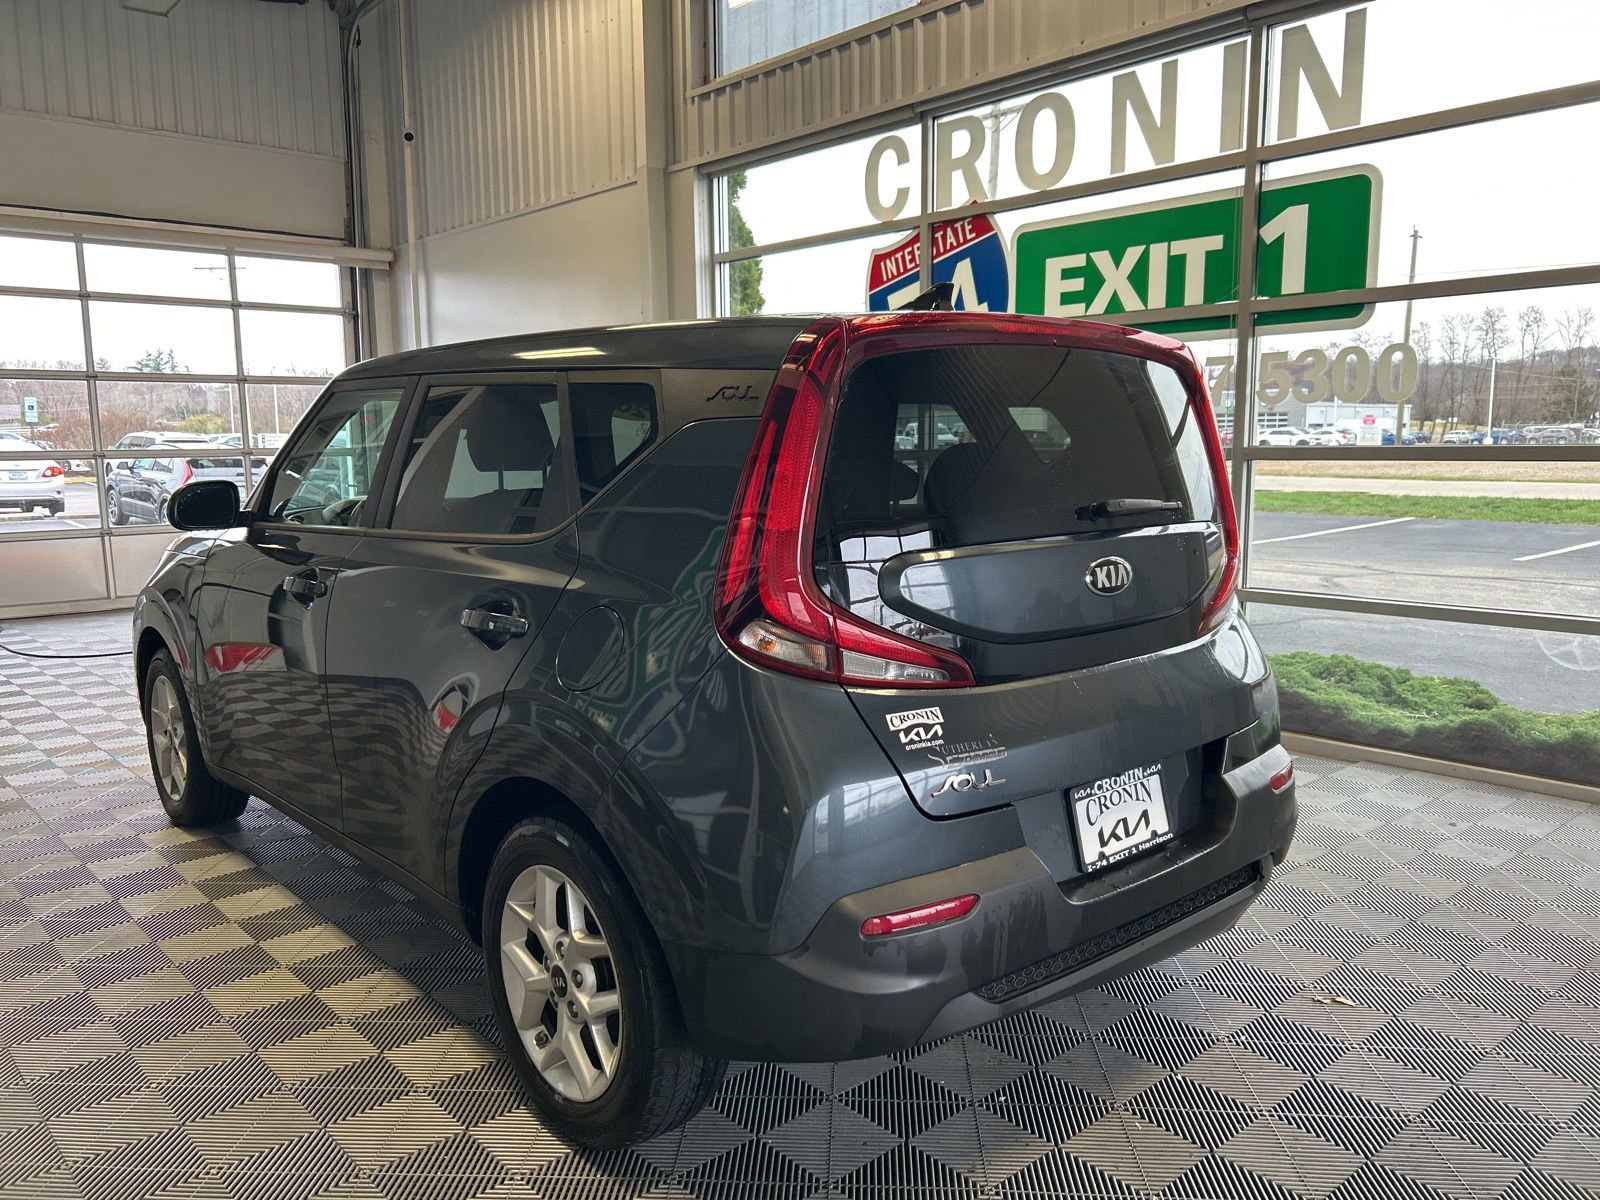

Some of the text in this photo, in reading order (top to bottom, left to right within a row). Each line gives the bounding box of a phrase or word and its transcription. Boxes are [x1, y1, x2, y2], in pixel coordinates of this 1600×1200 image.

[865, 7, 1368, 223] CRONIN
[880, 217, 977, 282] INTERTATE
[1044, 203, 1309, 316] EXIT 1
[1256, 342, 1418, 406] 5300
[706, 385, 759, 402] SOUL
[1094, 563, 1128, 589] KIA
[889, 708, 941, 728] CRONIN
[898, 724, 943, 744] KIA
[905, 739, 945, 751] croninkia.com
[931, 768, 1006, 798] SOUL
[1094, 767, 1143, 795] CRONIN
[1086, 778, 1153, 827] CRONIN
[1098, 808, 1150, 849] KIA
[1087, 859, 1108, 872] I-74
[1109, 849, 1130, 863] EXIT
[1138, 832, 1174, 851] Harrison
